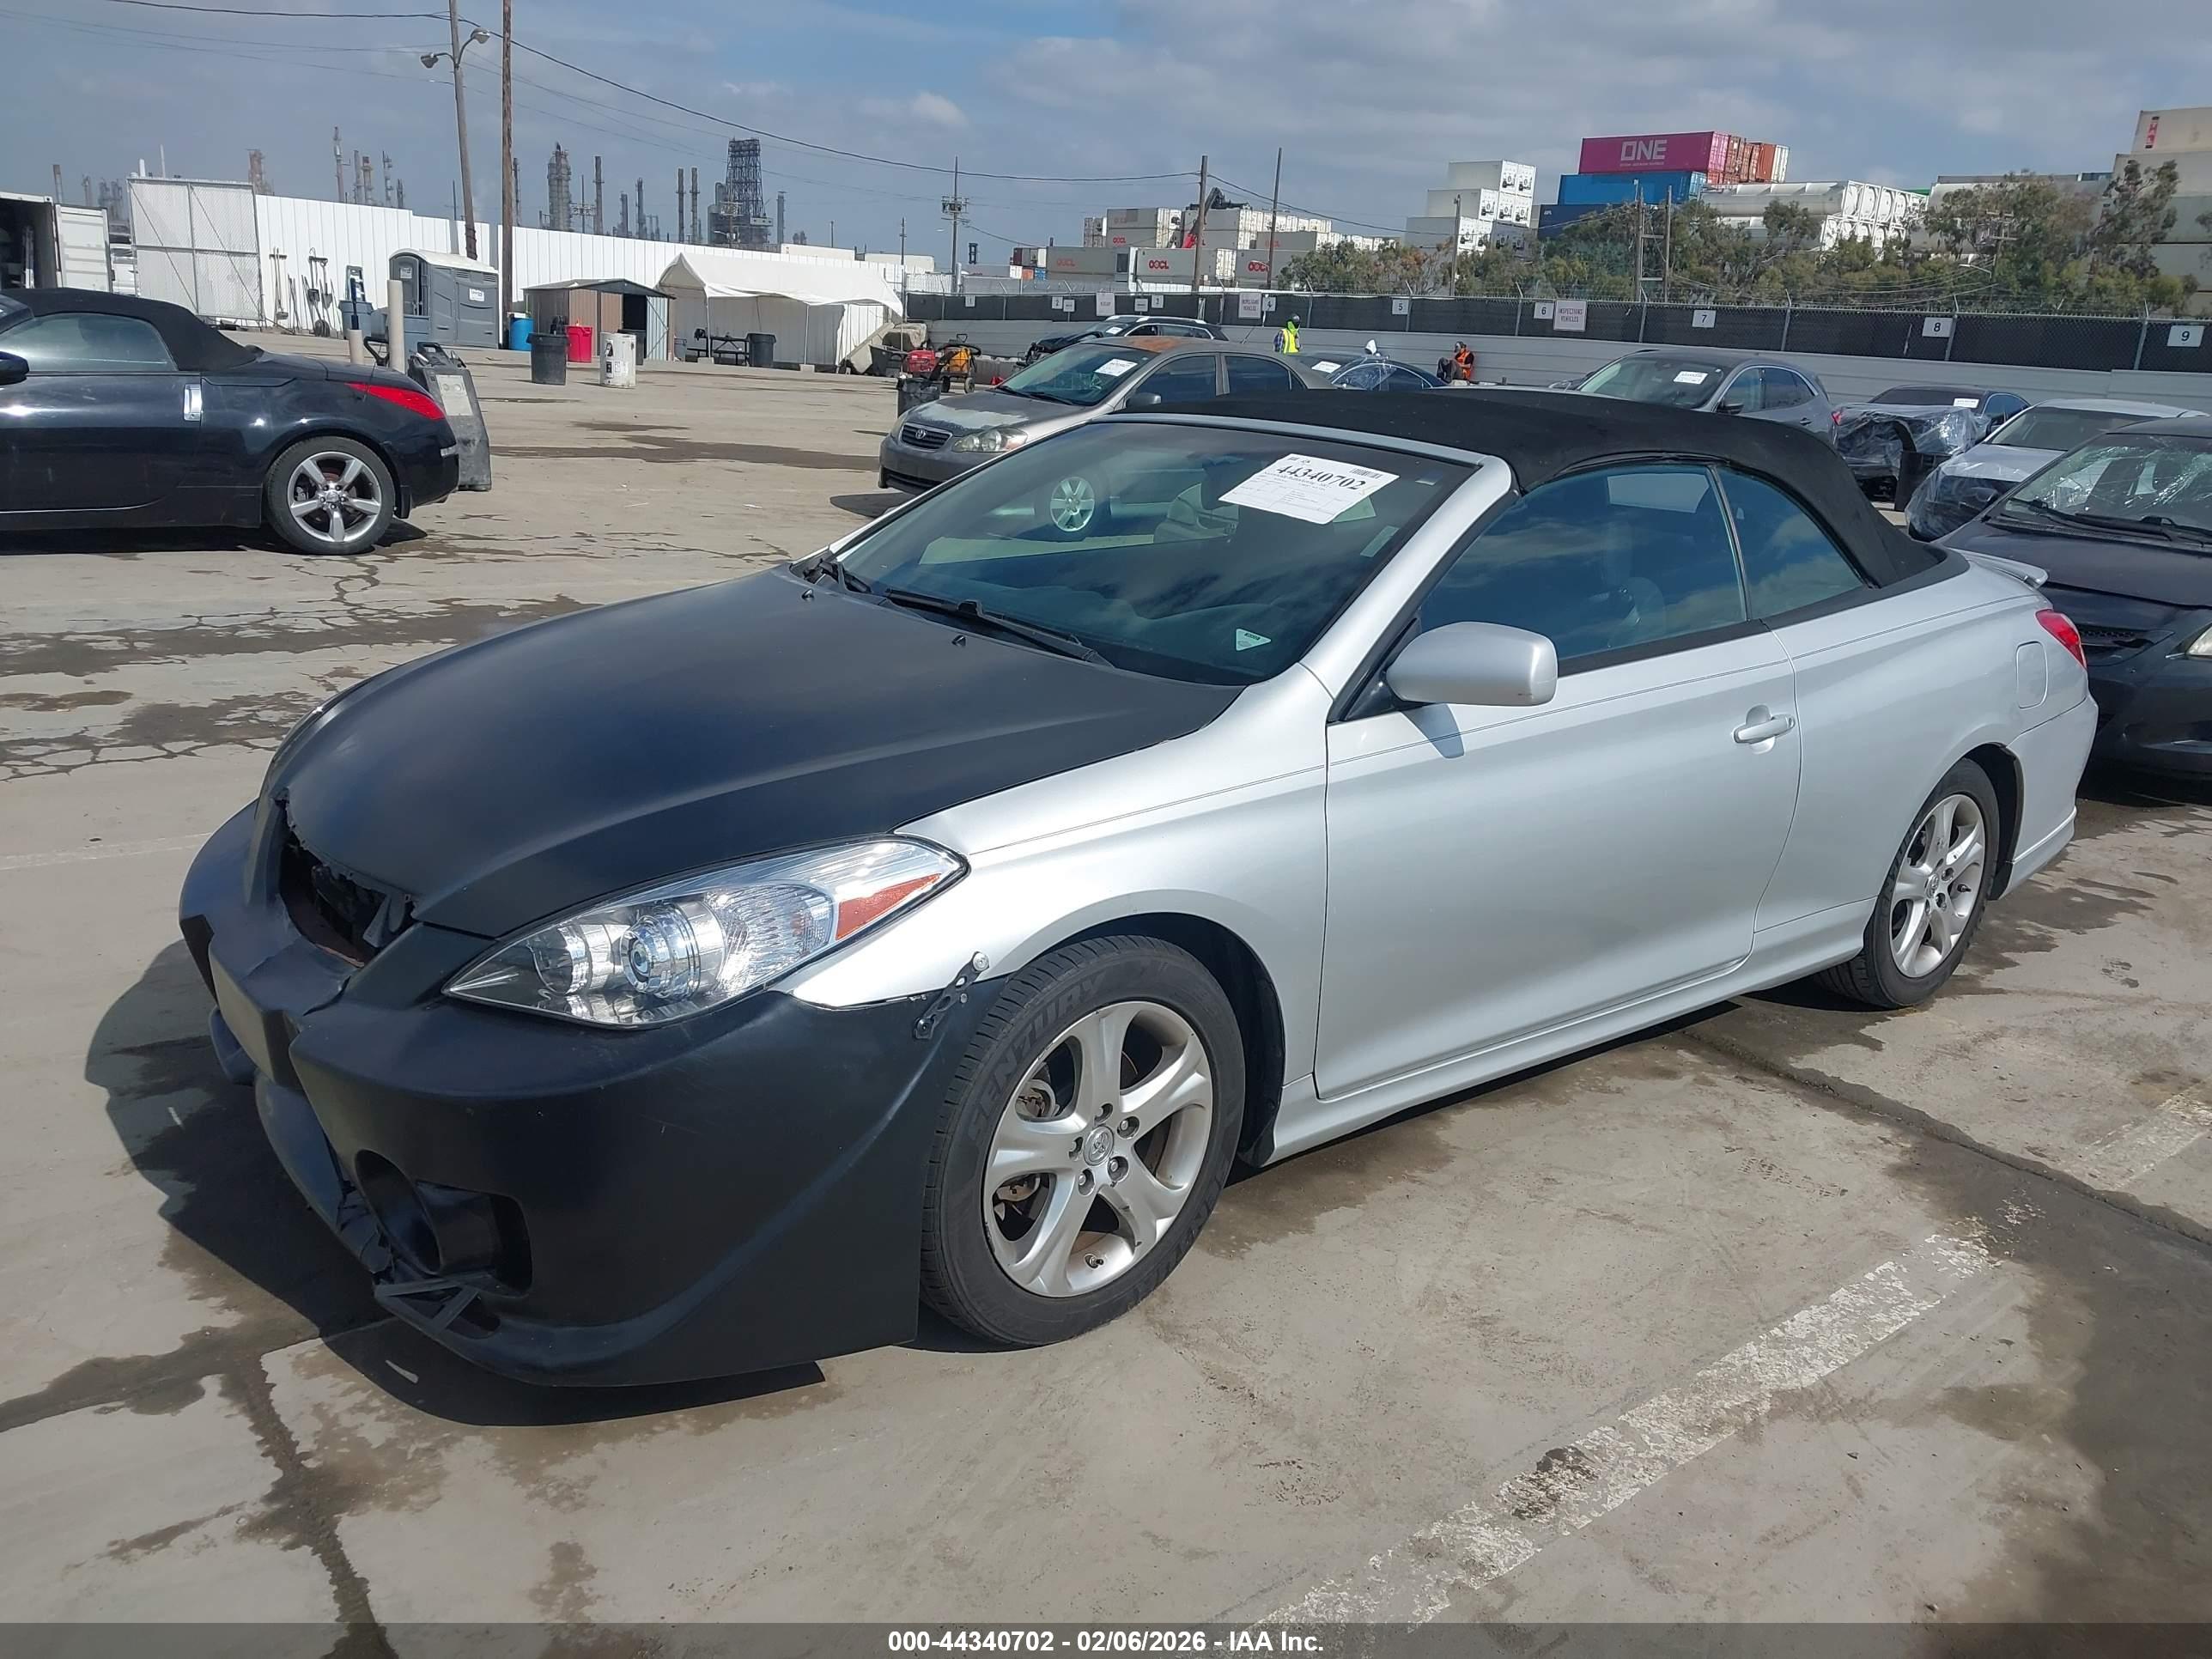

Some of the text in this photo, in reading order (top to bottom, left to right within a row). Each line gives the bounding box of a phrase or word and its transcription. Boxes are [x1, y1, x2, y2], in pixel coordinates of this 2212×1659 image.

[1621, 140, 1668, 161] ONE
[1149, 260, 1169, 269] OOCL
[1541, 307, 1547, 315] 6
[1701, 314, 1707, 324] 7
[1934, 322, 1941, 332] 8
[2181, 331, 2191, 342] 9
[1276, 465, 1366, 490] 44340702
